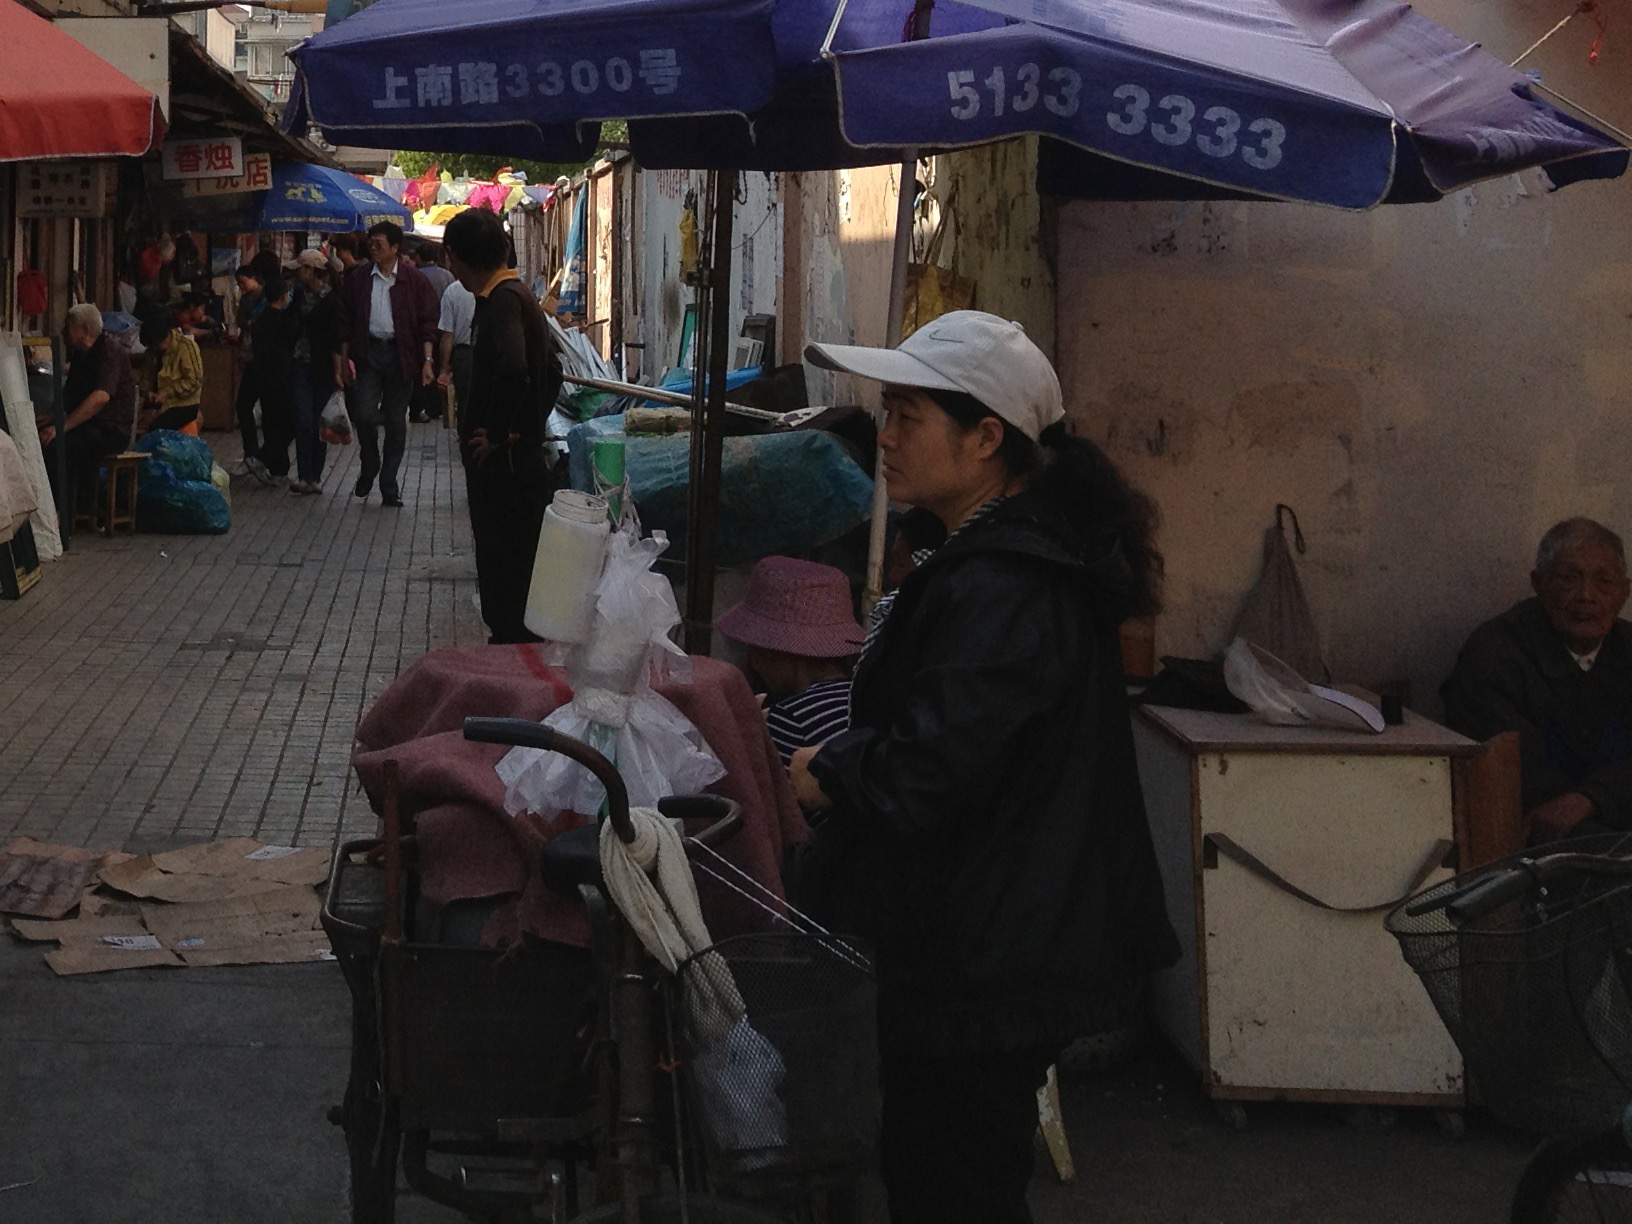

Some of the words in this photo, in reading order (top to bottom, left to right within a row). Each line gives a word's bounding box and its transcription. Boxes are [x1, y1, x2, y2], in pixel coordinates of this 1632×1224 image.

[373, 48, 682, 109] 上南路3300号
[947, 63, 1082, 119] 5133
[1107, 84, 1286, 170] 3333
[175, 142, 234, 173] 香烛
